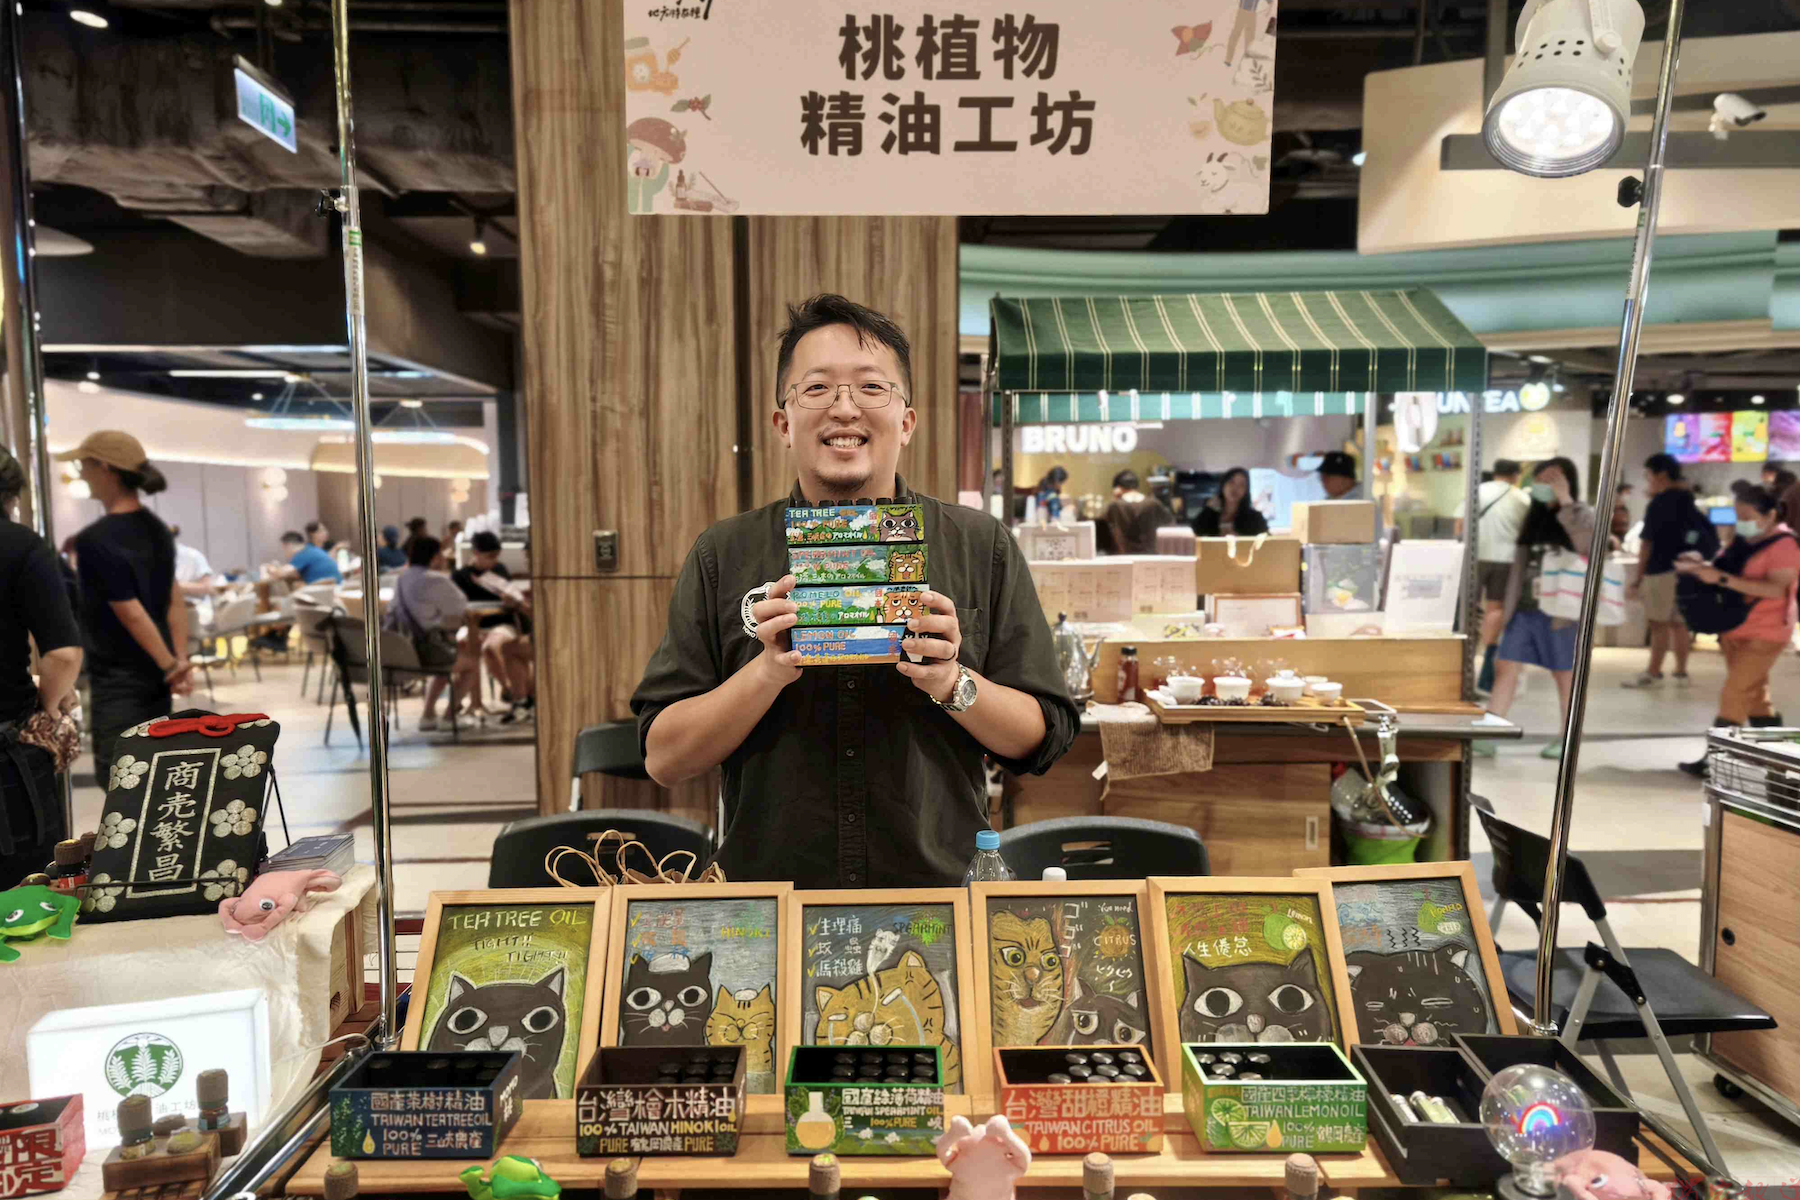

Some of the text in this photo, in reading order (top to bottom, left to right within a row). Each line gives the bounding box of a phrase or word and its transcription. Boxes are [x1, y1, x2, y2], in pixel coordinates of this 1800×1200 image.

[838, 13, 1060, 81] 桃植物
[800, 91, 1096, 157] 精油工坊
[1021, 425, 1138, 453] BRUNO
[789, 509, 809, 518] TEA
[811, 508, 835, 517] TREE
[844, 589, 862, 598] OIL
[820, 600, 842, 609] PURE
[793, 629, 856, 641] LEMON OIL
[794, 641, 847, 653] 100% PURE
[148, 761, 204, 881] 商売繁昌
[448, 909, 587, 930] TEA TREE OIL
[1286, 908, 1313, 925] Lemon
[819, 914, 863, 936] 生理痛
[1093, 934, 1137, 946] CITRUS
[578, 1086, 736, 1123] 台灣檜木精油
[842, 1105, 944, 1116] TAIWAN SPEARMINT OIL
[1005, 1087, 1162, 1120] 台灣甜橙精油
[1245, 1104, 1364, 1118] TAIWAN LEMON OIL
[370, 1113, 423, 1127] TAIWAN
[1025, 1119, 1159, 1135] TAIWAN CITRUS OIL
[1283, 1121, 1314, 1133] 100%
[383, 1129, 422, 1141] 100%
[619, 1121, 669, 1136] TAIWAN
[671, 1120, 718, 1134] HINOKI
[719, 1122, 737, 1133] OIL
[383, 1142, 422, 1156] PURE
[600, 1138, 628, 1153] PURE
[684, 1136, 714, 1152] PURE
[1057, 1133, 1139, 1151] 100% PURE
[1281, 1135, 1314, 1149] PURE
